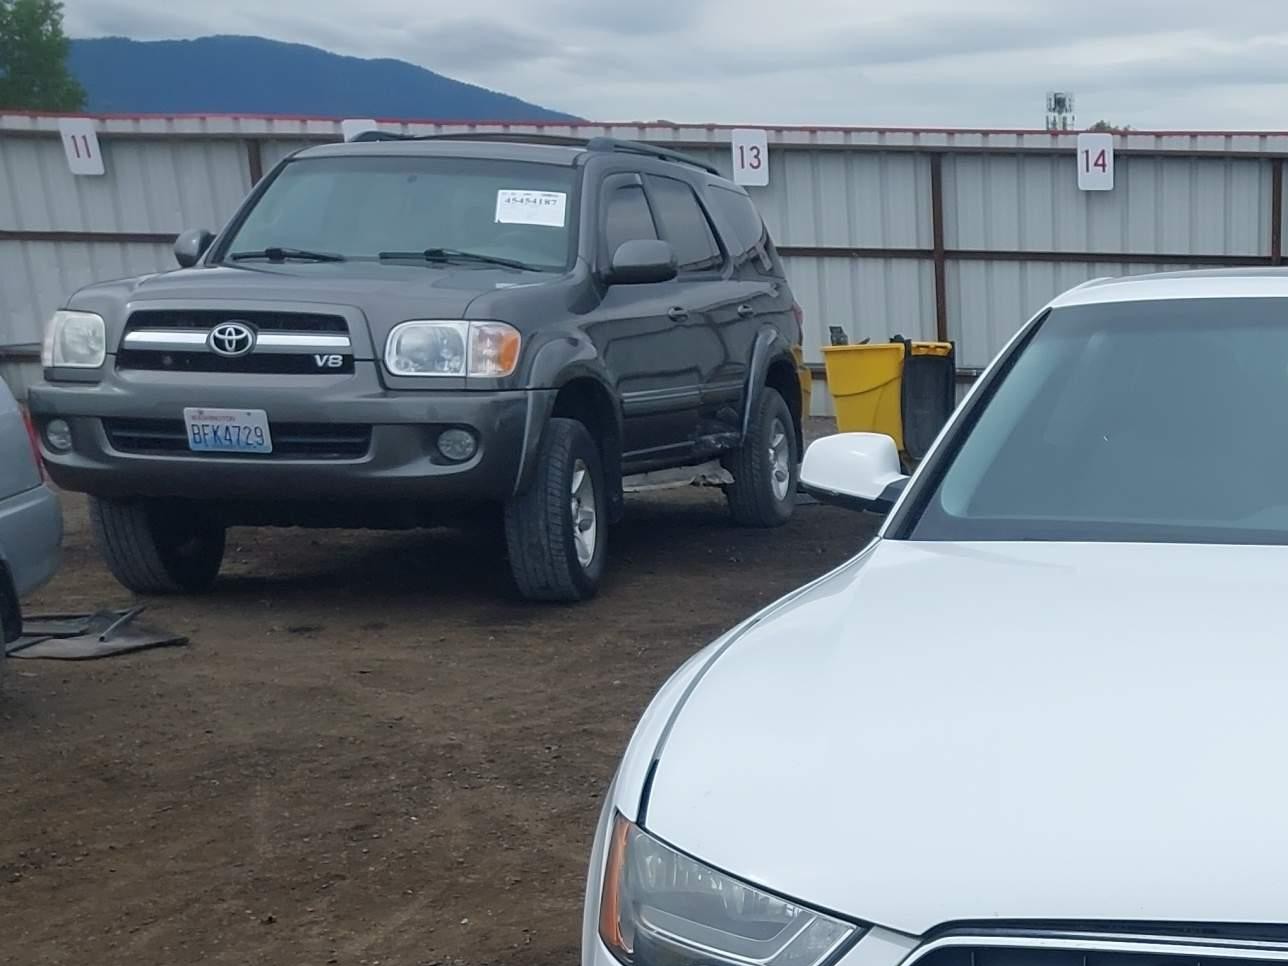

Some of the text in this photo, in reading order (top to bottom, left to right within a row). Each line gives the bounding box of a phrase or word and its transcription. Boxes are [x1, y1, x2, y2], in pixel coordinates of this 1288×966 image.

[71, 134, 91, 159] 11
[739, 145, 761, 170] 13
[1084, 149, 1107, 173] 14
[314, 354, 344, 368] V8
[191, 424, 264, 447] BFK4729
